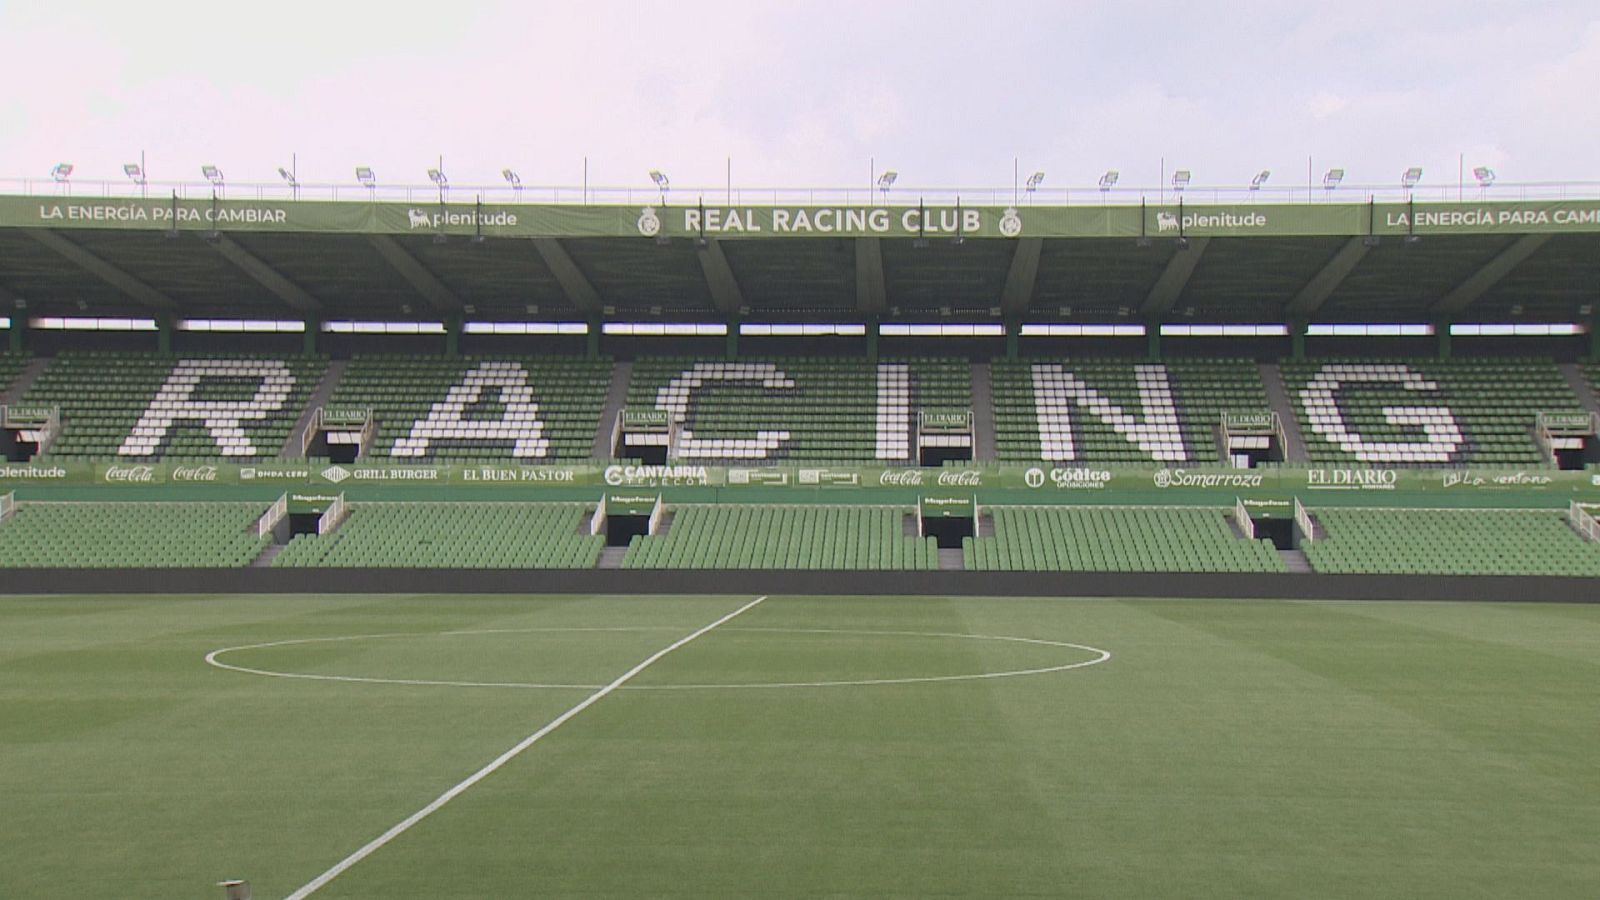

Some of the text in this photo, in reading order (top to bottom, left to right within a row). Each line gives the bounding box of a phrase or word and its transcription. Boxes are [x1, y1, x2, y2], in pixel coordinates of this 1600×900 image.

[39, 203, 287, 224] LA ENERGÍA PARA CAMBIAR
[433, 210, 518, 227] plenitude
[684, 209, 980, 232] REAL RACING CLUB
[1182, 212, 1267, 230] plenitude
[1386, 212, 1410, 226] LA
[1414, 208, 1495, 226] ENERGÍA
[1498, 210, 1549, 225] PARA
[117, 359, 1465, 466] RACING
[353, 469, 389, 480] GRILL
[390, 469, 438, 480] BURGER
[463, 469, 574, 482] EL BUEN PASTOR
[624, 466, 707, 478] CANTABRIA
[1171, 469, 1263, 488] Somarroza
[1308, 469, 1397, 484] EL DIARIO
